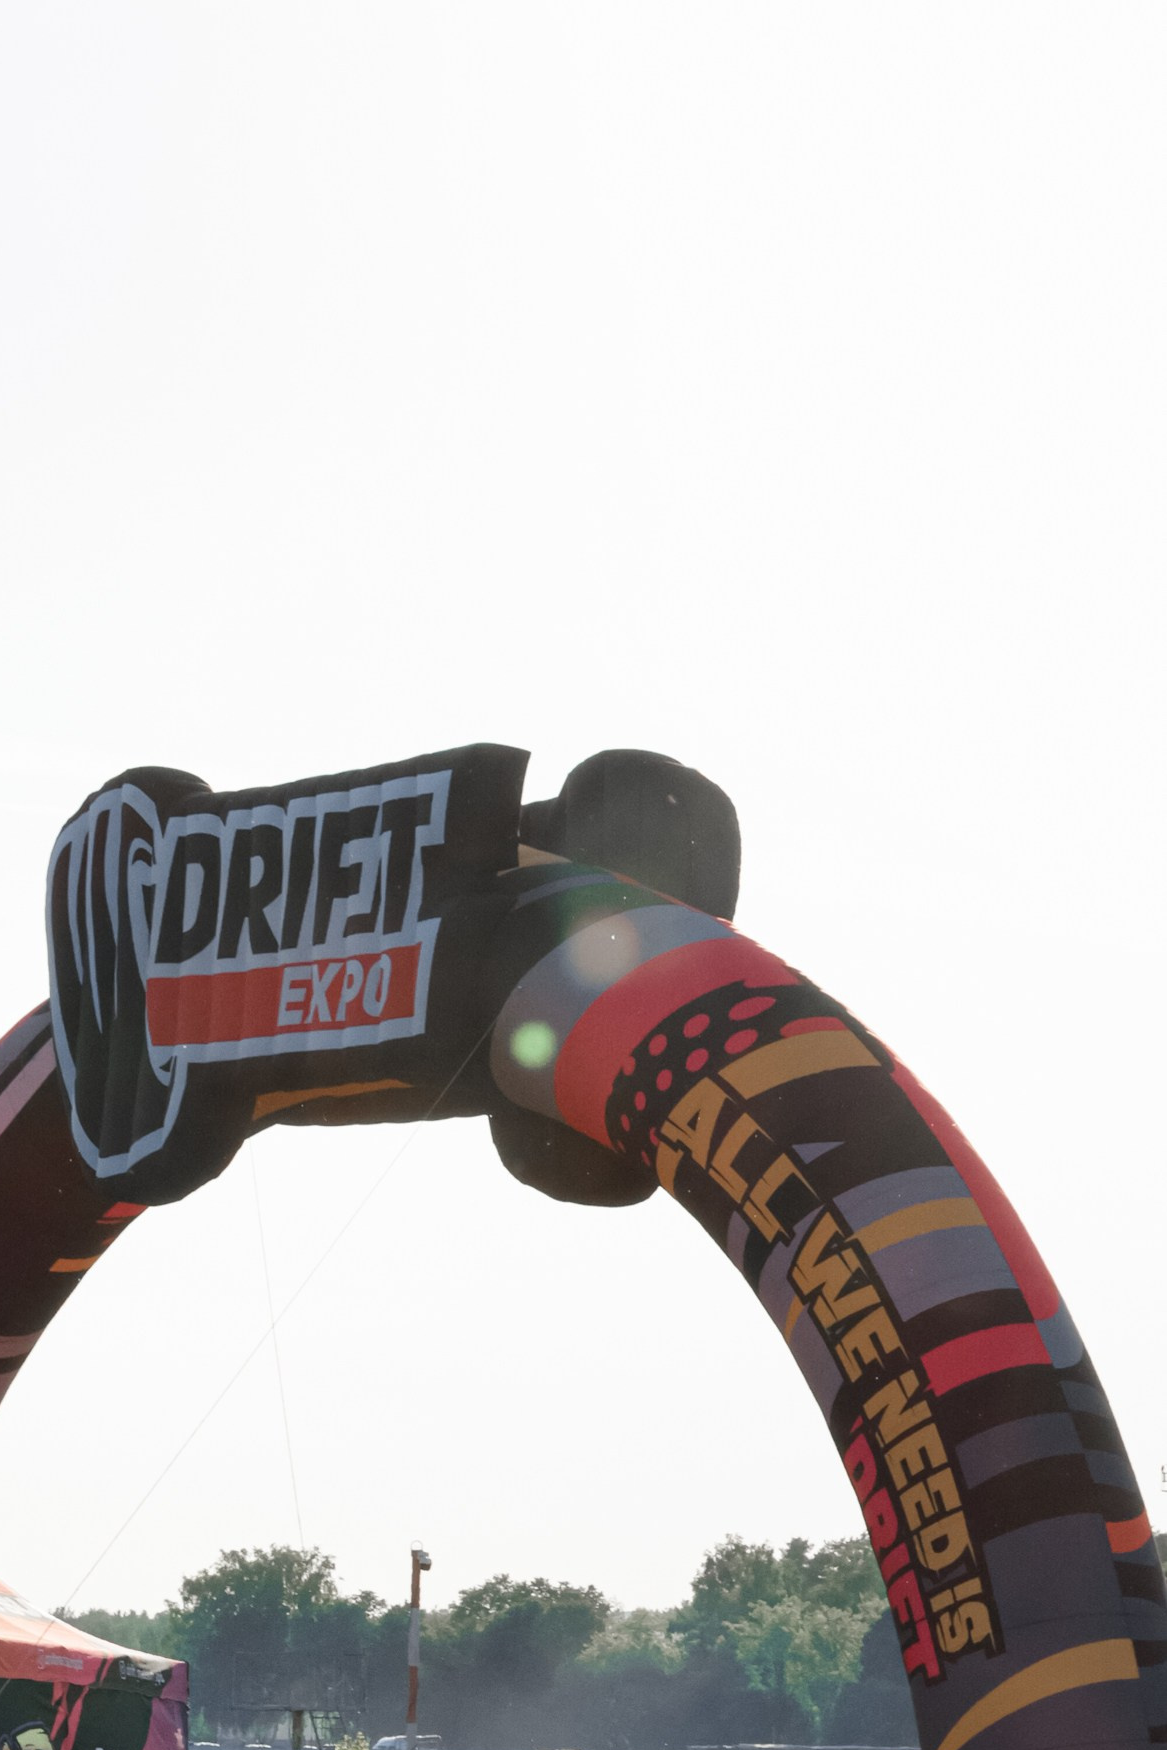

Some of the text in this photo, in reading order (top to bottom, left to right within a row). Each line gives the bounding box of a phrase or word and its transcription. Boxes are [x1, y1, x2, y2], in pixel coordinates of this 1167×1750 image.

[154, 787, 439, 965] DRIFT
[277, 956, 393, 1028] EXPO
[660, 1076, 998, 1655] ALL WE NEED IS
